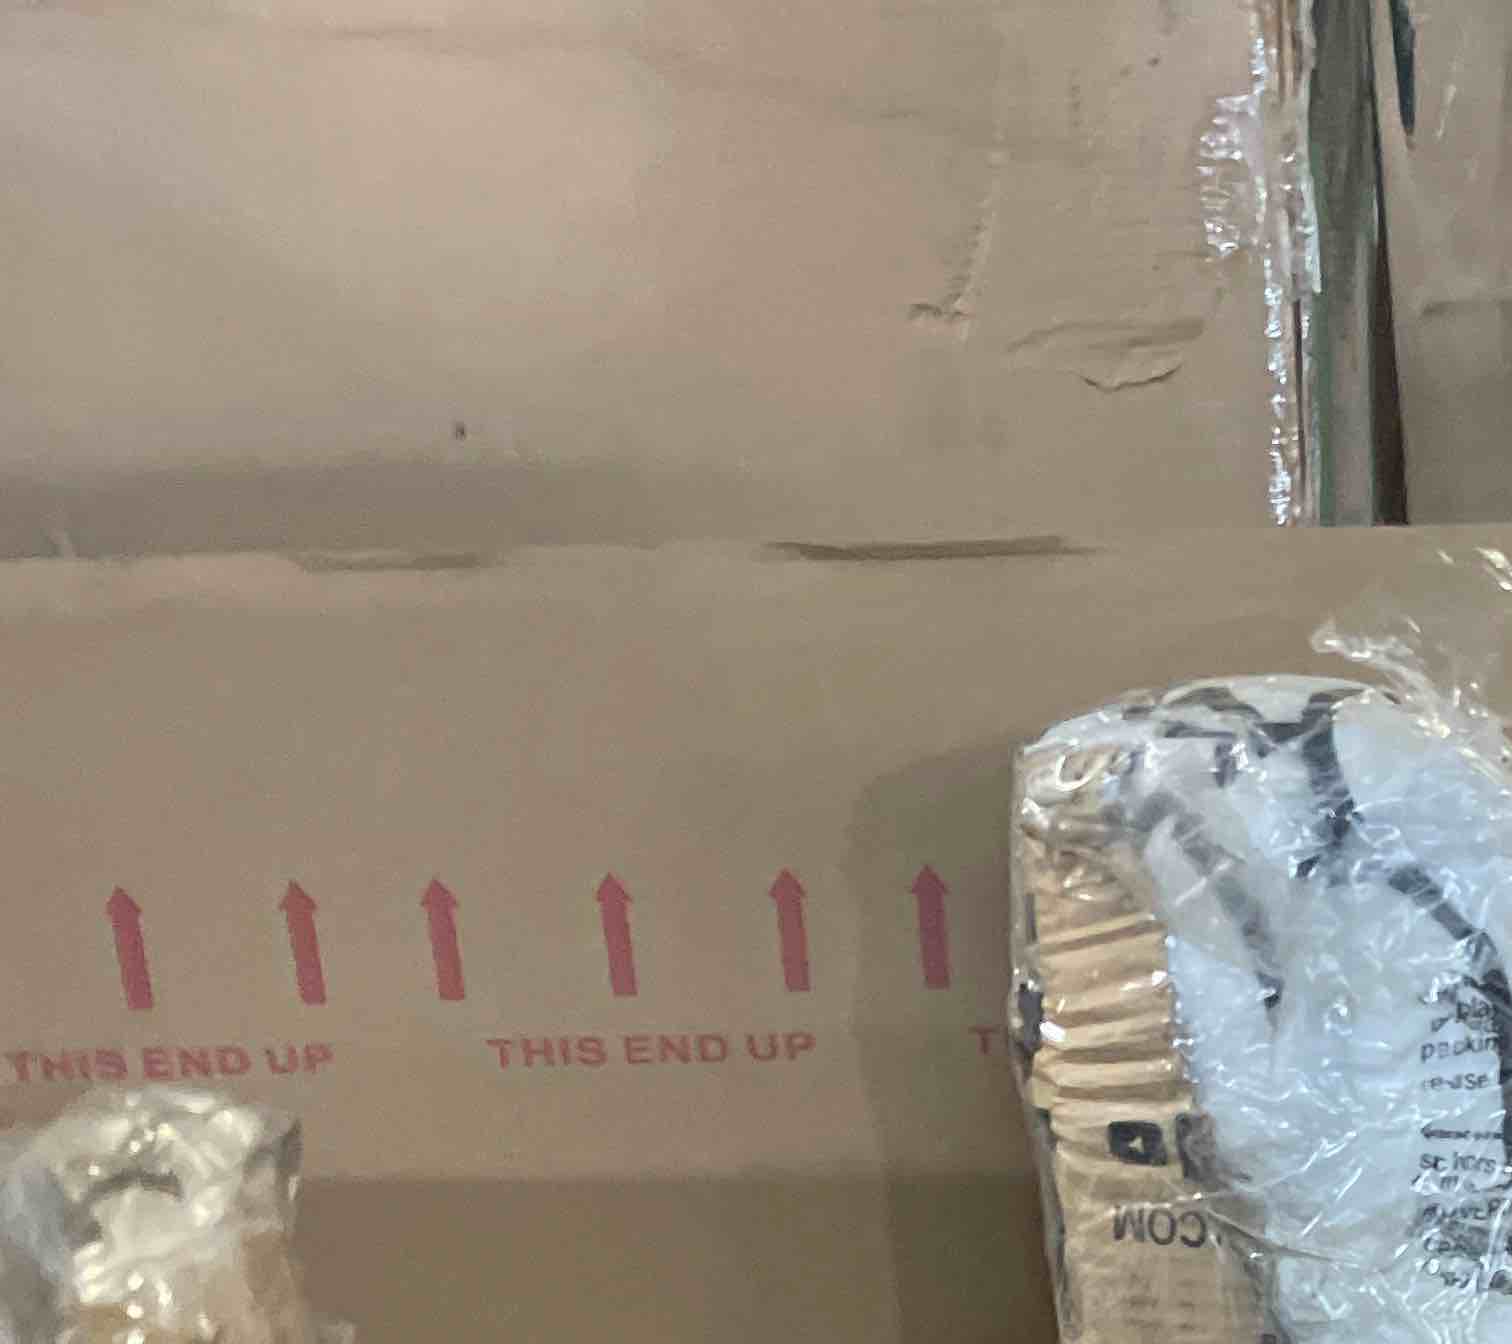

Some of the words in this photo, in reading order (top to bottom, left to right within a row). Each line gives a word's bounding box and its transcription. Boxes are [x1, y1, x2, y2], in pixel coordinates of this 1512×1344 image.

[7, 1048, 129, 1082] THIS
[142, 1044, 250, 1080] END
[265, 1042, 336, 1075] UP
[485, 1036, 608, 1070] THIS
[622, 1034, 729, 1065] END
[746, 1031, 817, 1062] UP
